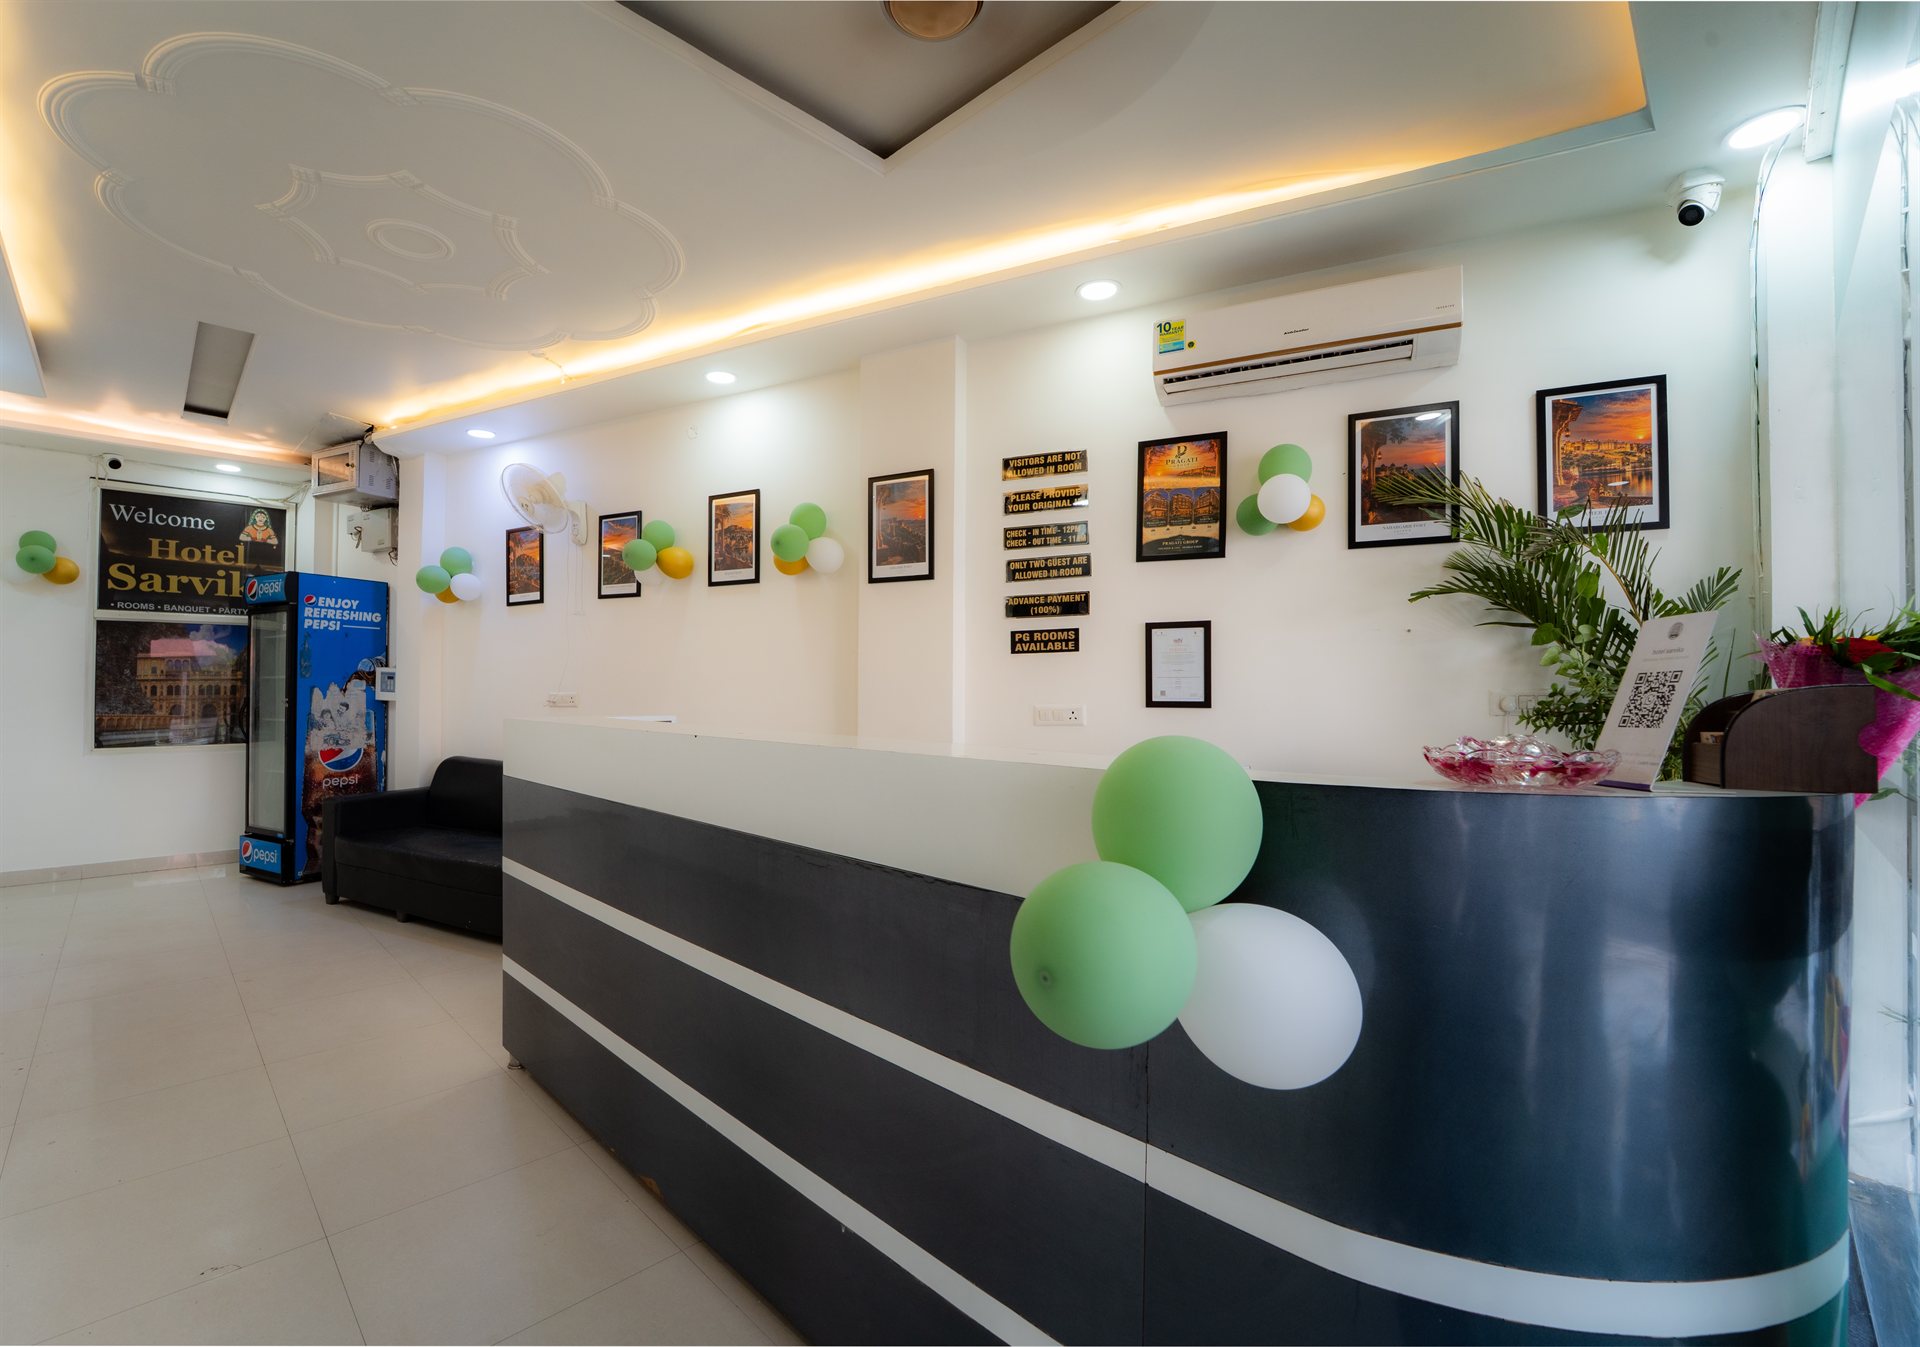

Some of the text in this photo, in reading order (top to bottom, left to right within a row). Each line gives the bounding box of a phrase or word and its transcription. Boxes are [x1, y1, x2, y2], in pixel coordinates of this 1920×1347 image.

[1157, 322, 1171, 333] 10
[1009, 452, 1081, 467] VISITORS ARE NOT
[1165, 457, 1198, 465] PRAGATI
[1006, 462, 1082, 477] ALLOWED IN ROOM
[1010, 488, 1081, 502] PLEASE PROVIDE
[1008, 503, 1030, 512] YOUR
[1032, 499, 1072, 510] ORIGINAL
[109, 503, 216, 531] Welcome
[1006, 529, 1027, 538] CHECK
[1032, 528, 1040, 536] IN
[1040, 527, 1057, 535] TIME
[1063, 525, 1079, 533] 12PM
[1006, 539, 1027, 548] CHECK
[1032, 537, 1045, 546] OUT
[1046, 536, 1062, 544] TIME
[148, 537, 246, 566] Hotel
[1010, 556, 1088, 570] ONLY TWO GUEST ARE
[1015, 567, 1082, 580] ALLOWED IN ROOM
[258, 578, 283, 598] pepsi
[318, 596, 360, 610] ENJOY
[1008, 593, 1086, 606] ADVANCE PAYMENT
[117, 601, 249, 615] ROOMS BANQUET PARTY
[304, 607, 382, 623] REFRESHING
[1030, 605, 1060, 616] (100%)
[304, 618, 341, 631] PEPSI
[1015, 630, 1076, 642] PG ROOMS
[1015, 641, 1075, 652] AVAILABLE
[322, 774, 360, 789] pepsi
[253, 847, 278, 864] pepsi
